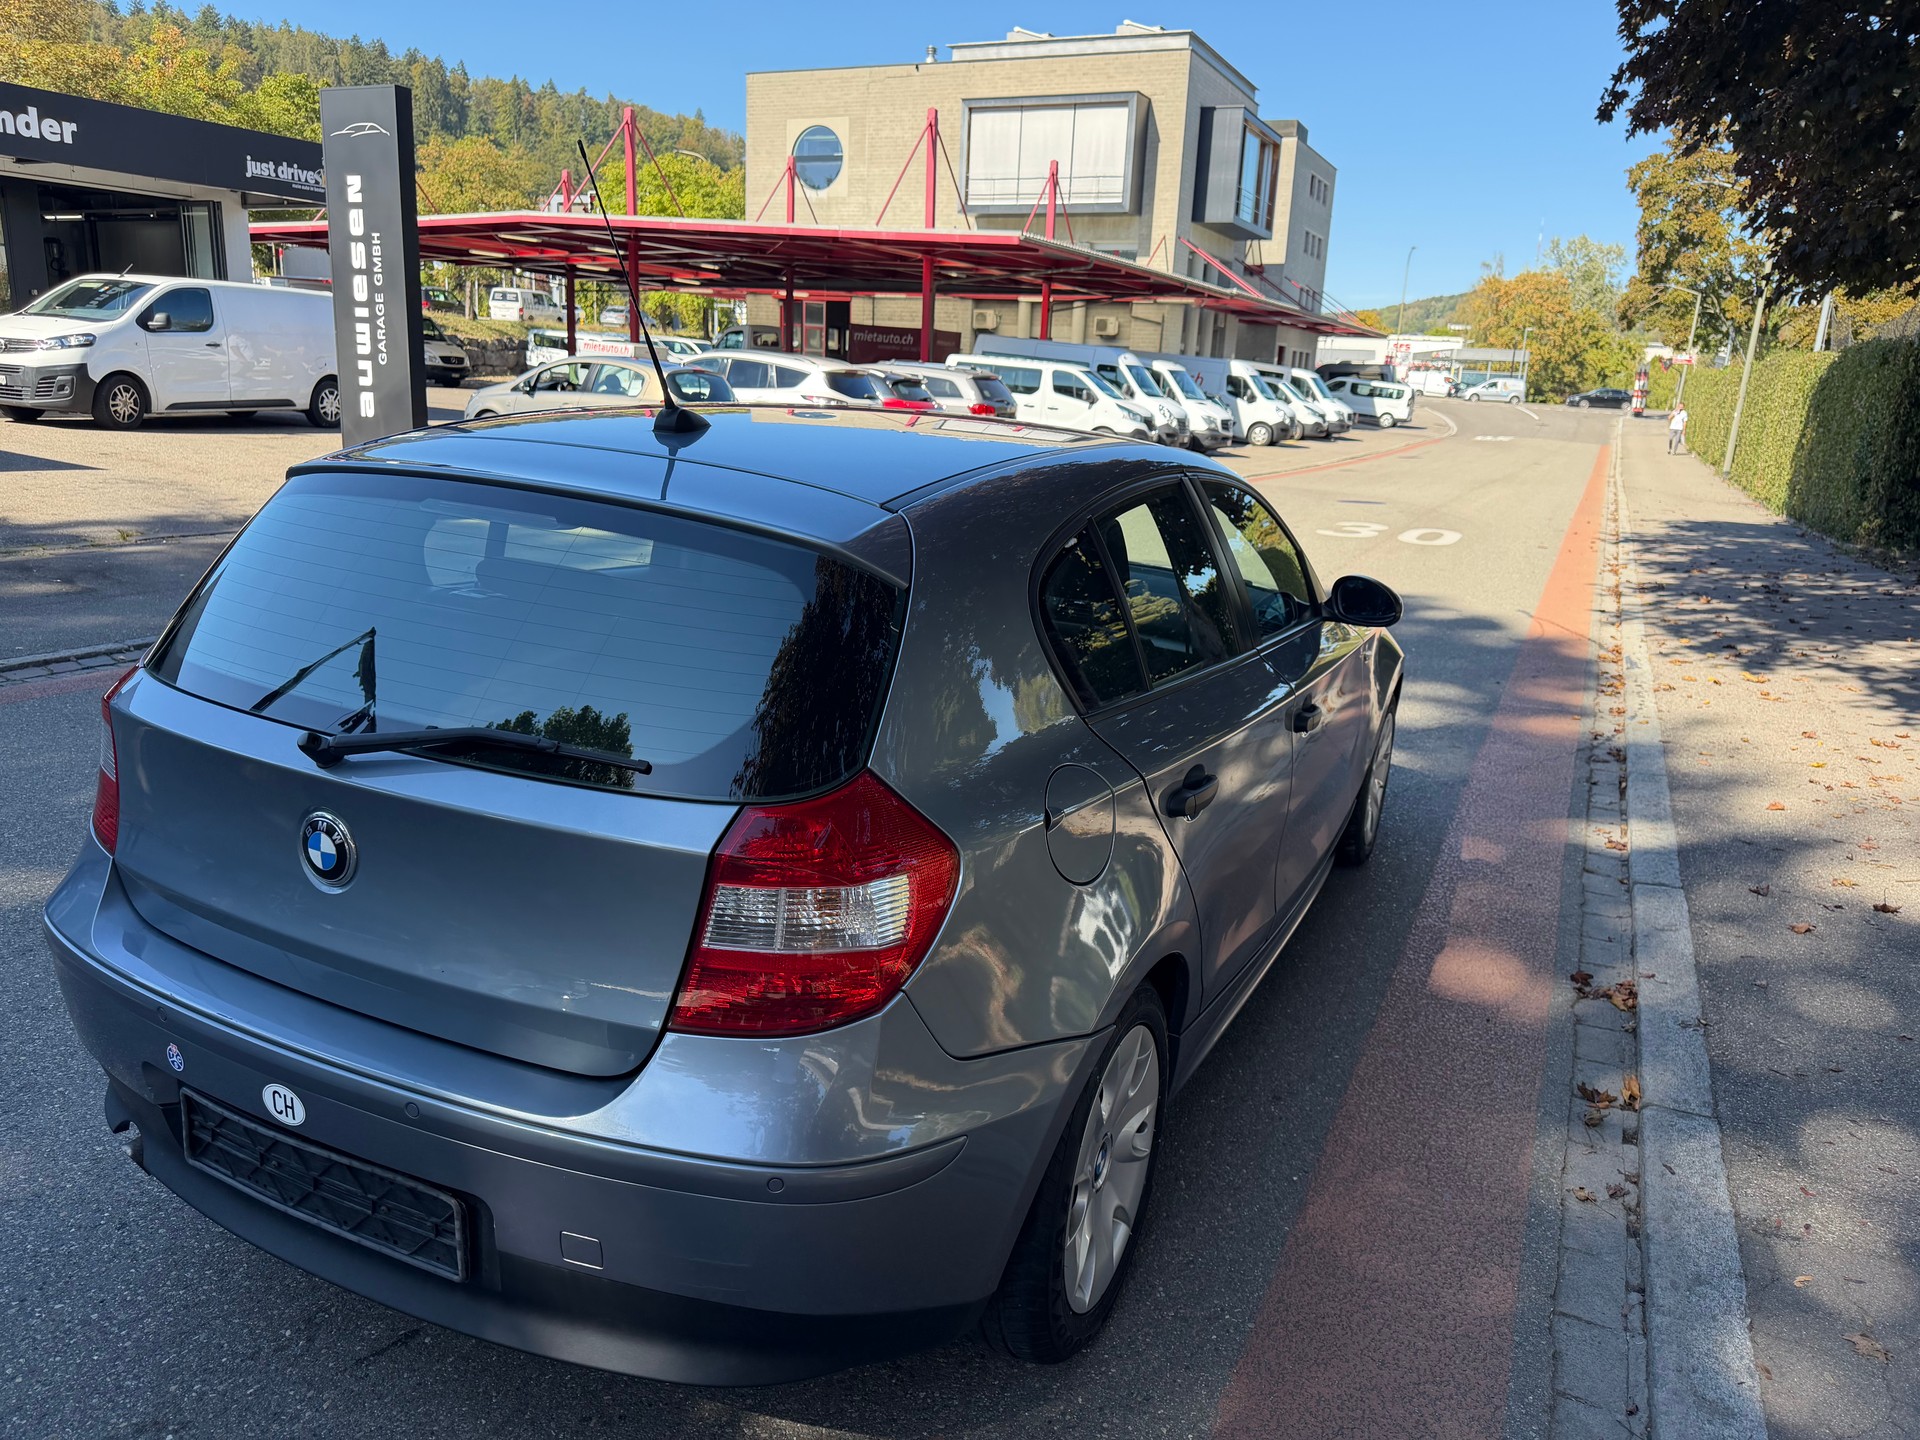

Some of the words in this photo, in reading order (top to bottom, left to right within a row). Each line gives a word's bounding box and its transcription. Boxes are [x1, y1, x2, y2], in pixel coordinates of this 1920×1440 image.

[245, 155, 276, 178] just
[371, 232, 384, 286] GMBH
[375, 292, 387, 366] GARAGE
[854, 330, 914, 345] mietauto.ch
[583, 342, 630, 355] mietauto.ch
[1315, 521, 1463, 546] 30
[305, 820, 343, 845] BMW
[272, 1090, 296, 1120] CH
